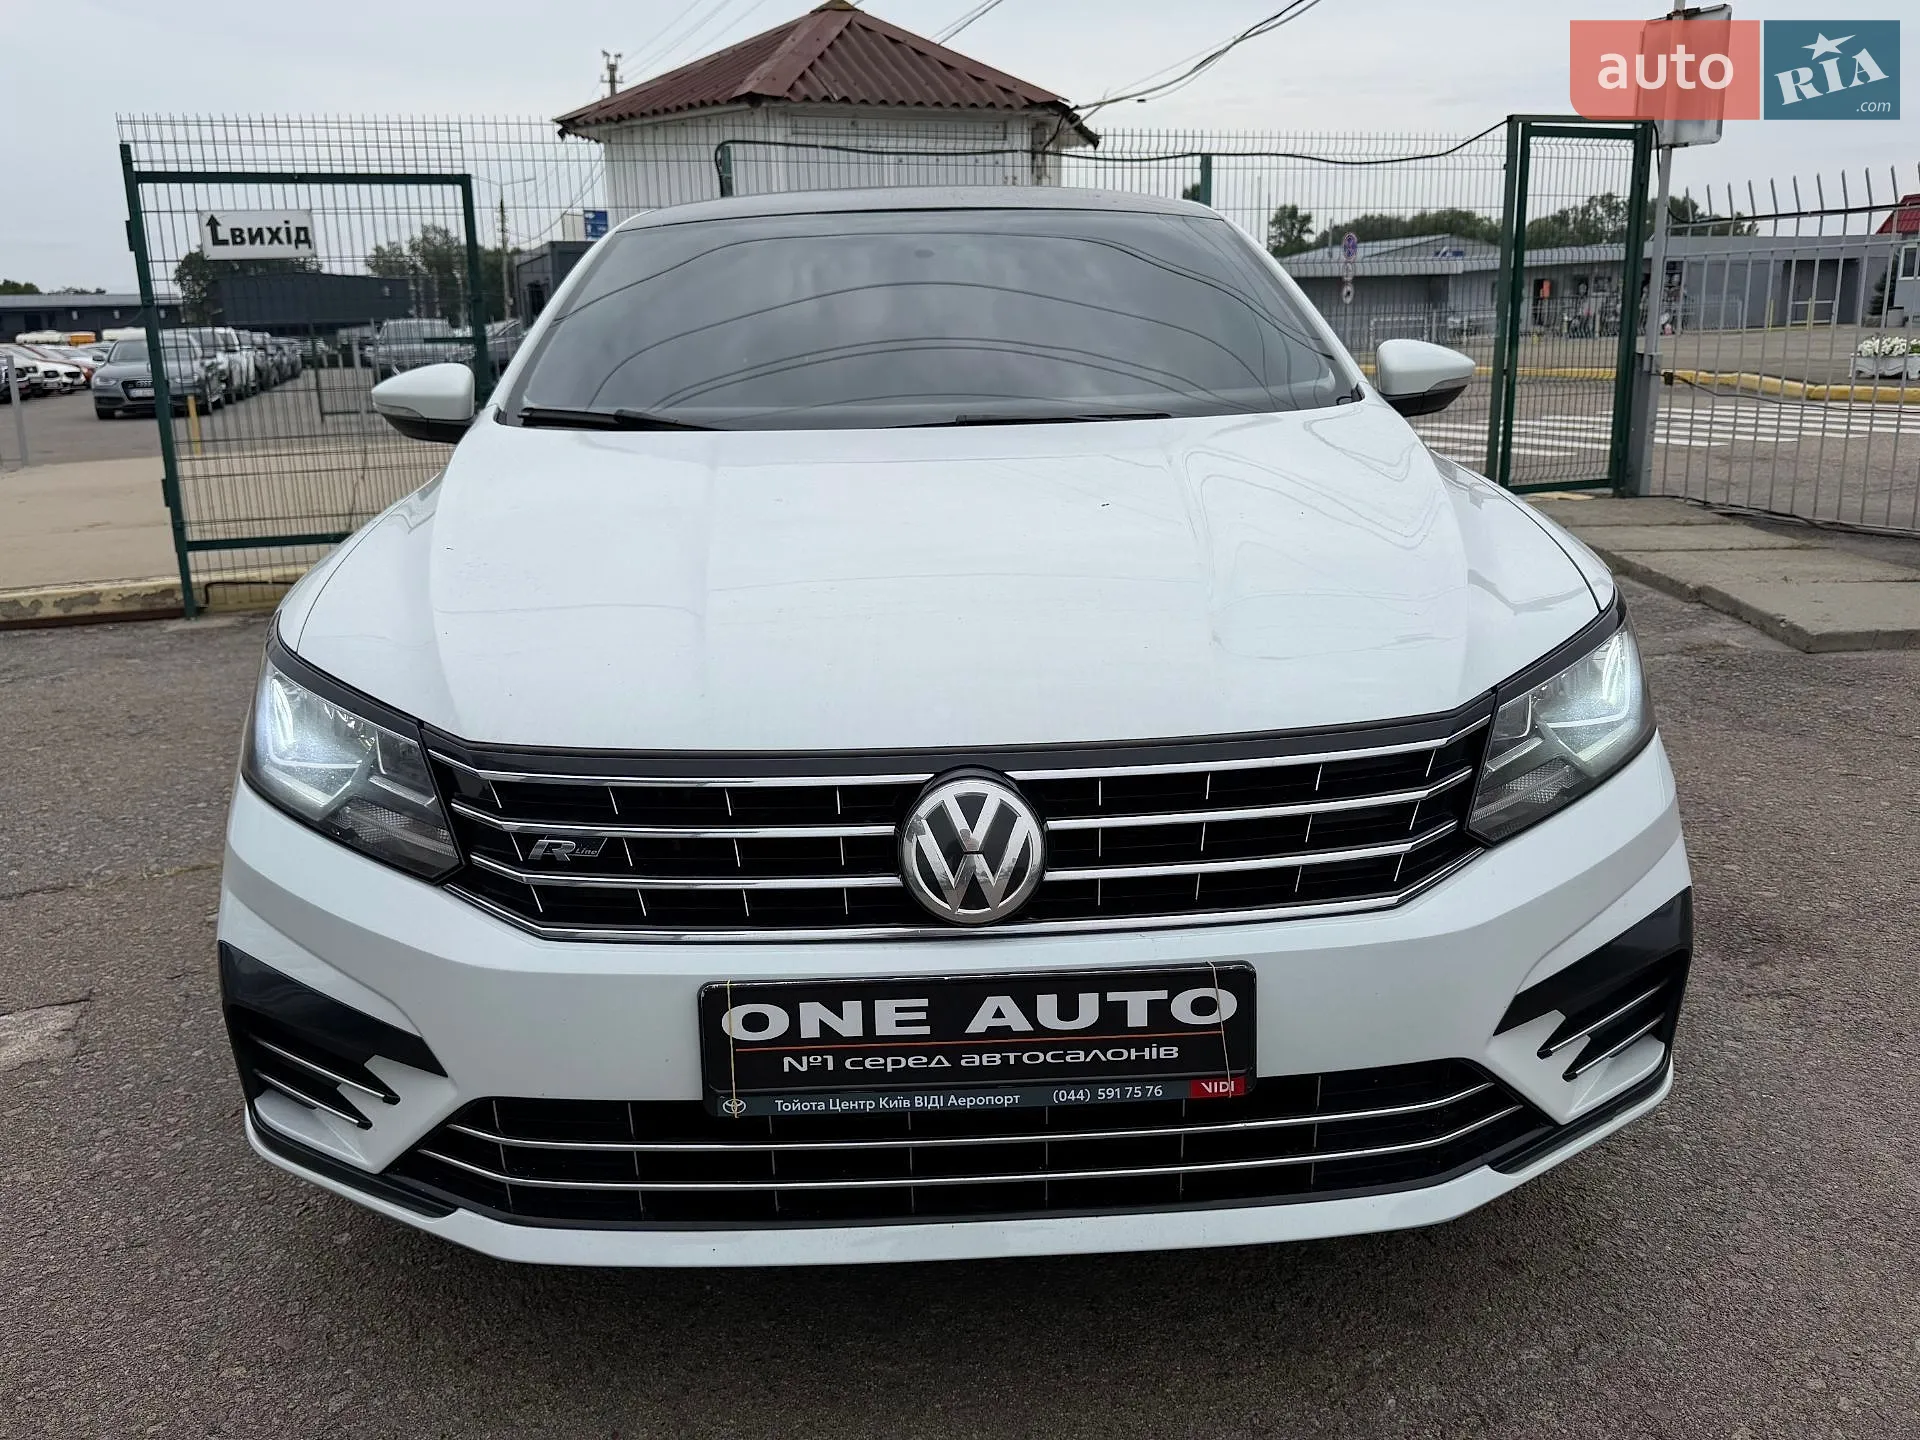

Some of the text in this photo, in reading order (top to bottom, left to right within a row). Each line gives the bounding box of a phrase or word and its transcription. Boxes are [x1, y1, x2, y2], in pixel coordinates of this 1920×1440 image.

[229, 219, 312, 250] вихід
[908, 784, 1036, 916] VW
[721, 987, 1238, 1041] ONE AUTO
[844, 1054, 952, 1073] серед
[960, 1043, 1179, 1067] автосалонів
[1052, 1085, 1163, 1104] (044) 591 75 76
[1200, 1080, 1235, 1094] VIDI
[774, 1094, 1021, 1112] Тойота Центр Київ ВІДІ Аеропорт
